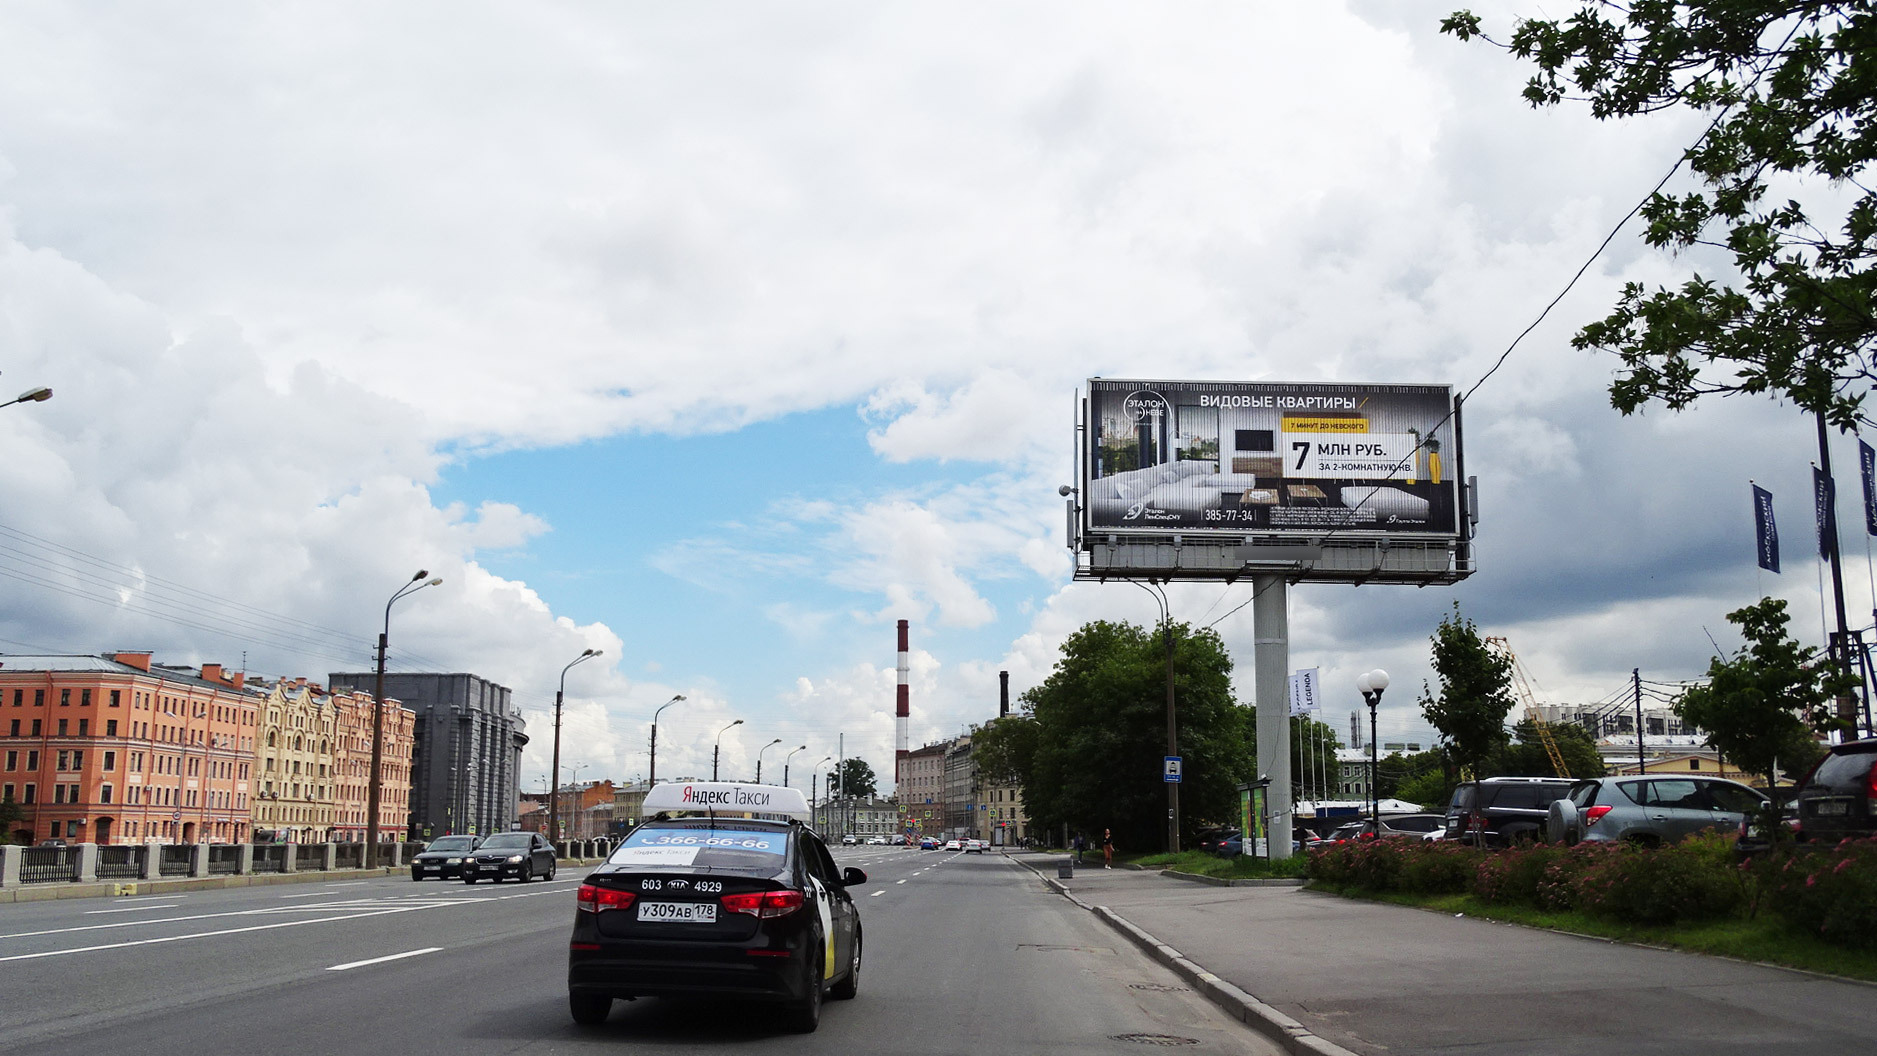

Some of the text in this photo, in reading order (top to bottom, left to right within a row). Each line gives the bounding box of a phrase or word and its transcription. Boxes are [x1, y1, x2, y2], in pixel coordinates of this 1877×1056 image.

[1128, 400, 1164, 408] ЭТАЛОН
[1200, 395, 1356, 409] ВИДОВЫЕ КВАРТИРЫ
[1292, 442, 1310, 470] 7
[1318, 443, 1387, 456] МЛН РУБ.
[1319, 463, 1330, 471] ЗА
[1333, 463, 1397, 471] 2-КОМНАТНУЮ
[1205, 509, 1253, 521] 385-77-34
[1304, 673, 1313, 705] LEGENDA
[682, 786, 770, 805] Яндекс Такси
[656, 836, 770, 849] 366-66-66
[641, 879, 662, 890] 603
[669, 881, 686, 890] KIA
[694, 881, 722, 892] 4929
[642, 904, 714, 918] У309АВ 178
